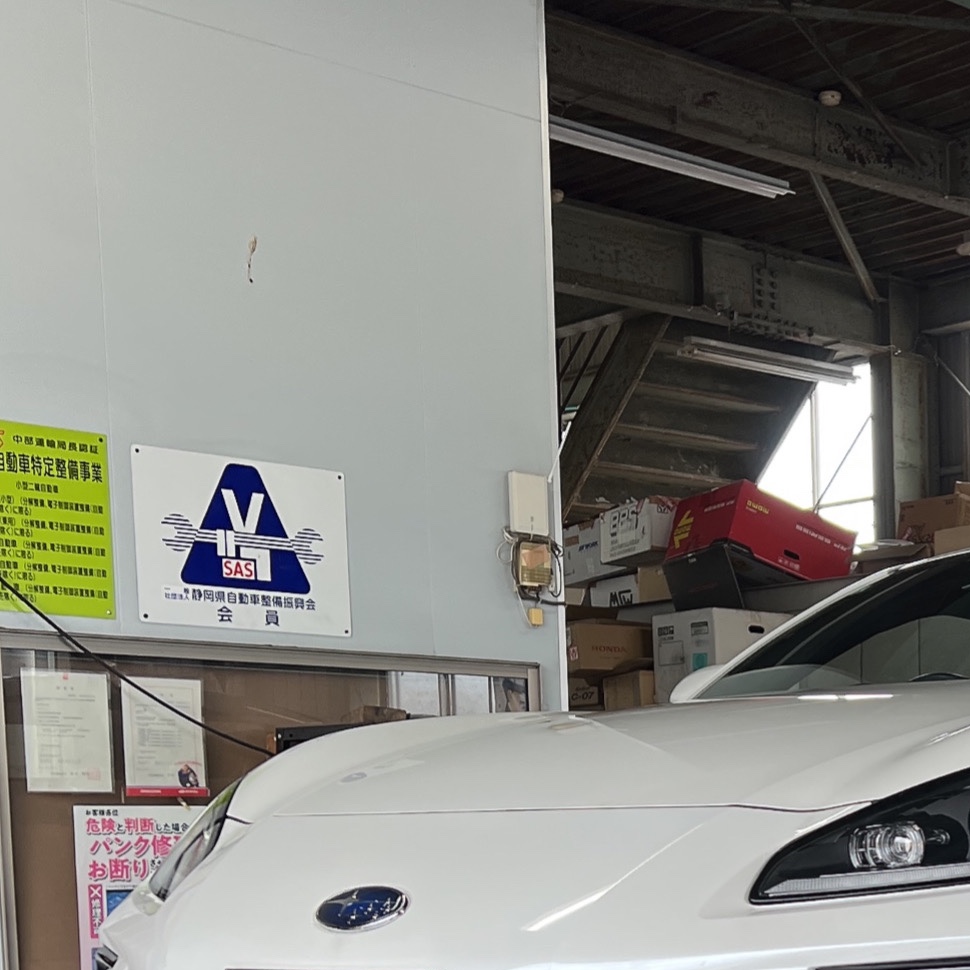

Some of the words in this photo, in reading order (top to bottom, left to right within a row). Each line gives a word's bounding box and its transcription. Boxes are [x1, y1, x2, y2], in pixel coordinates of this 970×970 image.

[223, 560, 254, 578] SAS
[90, 834, 181, 858] パンク修
